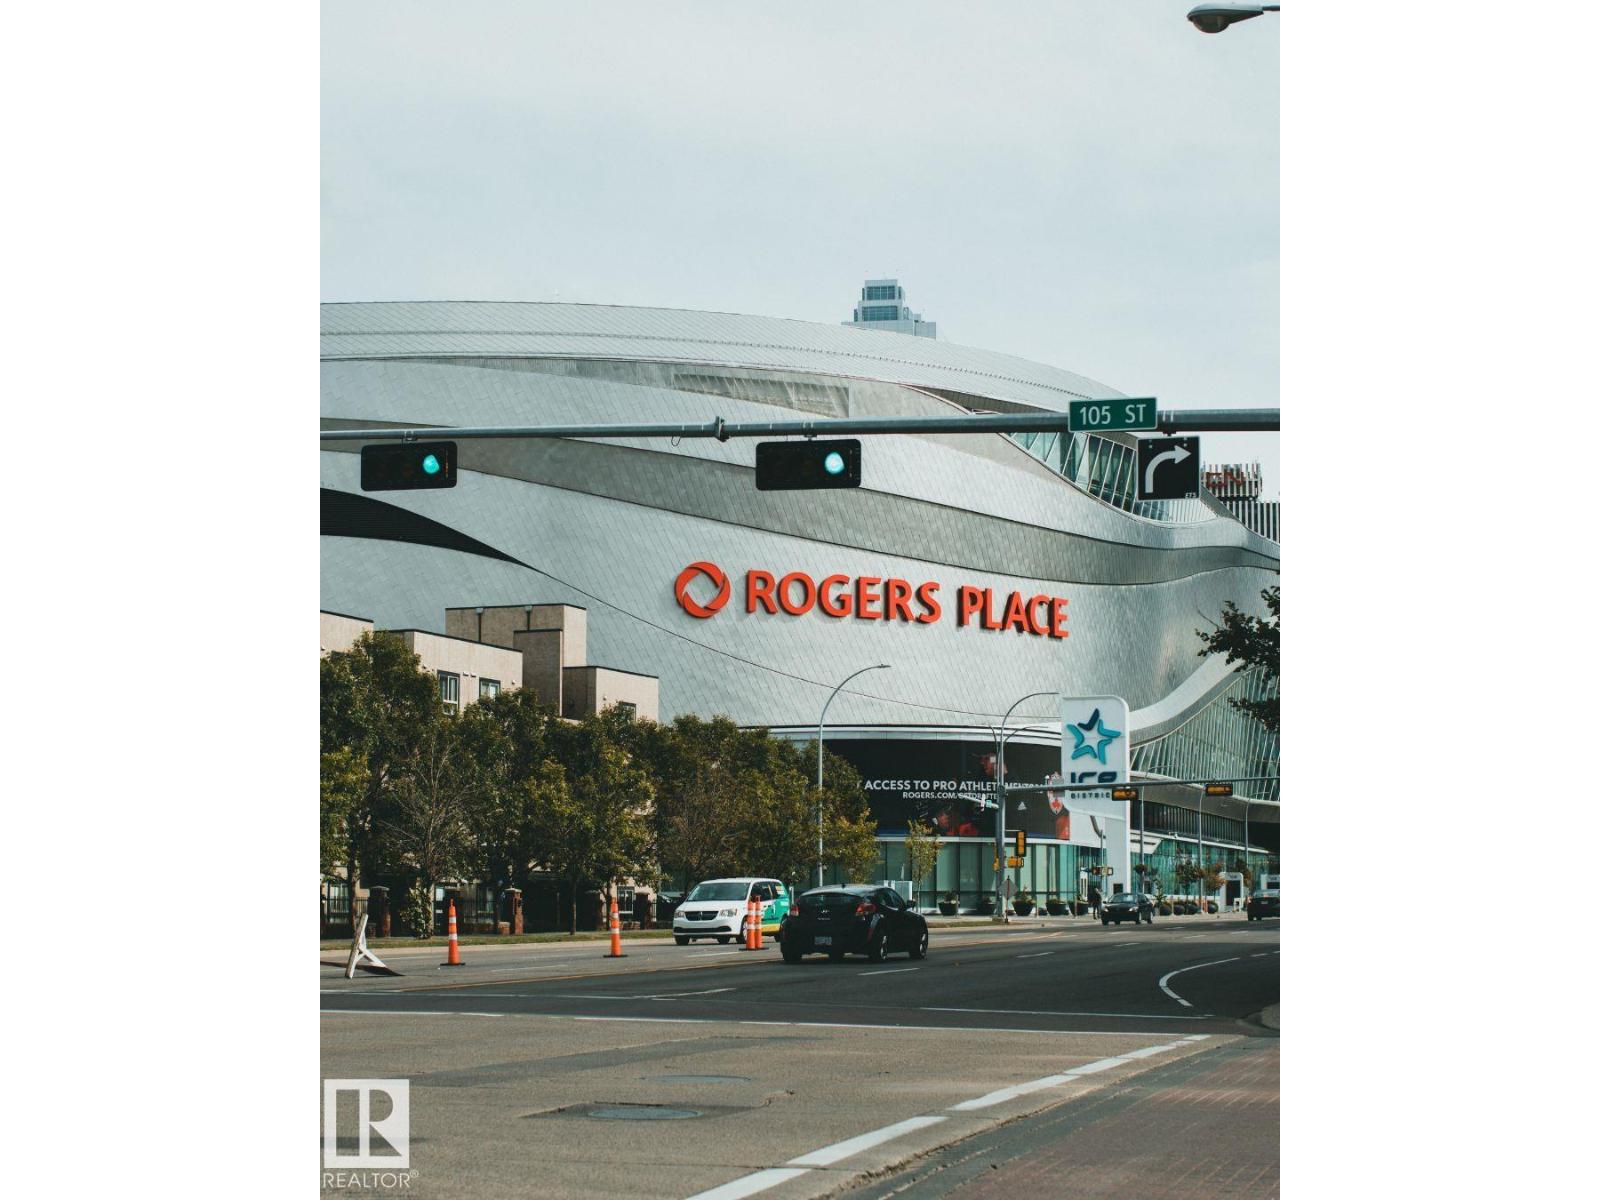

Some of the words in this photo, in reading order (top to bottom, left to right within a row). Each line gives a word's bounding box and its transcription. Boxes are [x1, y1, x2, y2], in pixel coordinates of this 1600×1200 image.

[1079, 405, 1111, 425] 105
[1125, 404, 1147, 423] ST
[746, 569, 941, 624] ROGERS
[958, 585, 1069, 639] PLACE
[864, 780, 911, 790] ACCESS
[913, 780, 931, 790] TO
[933, 780, 957, 790] PRO
[959, 781, 998, 791] ATHLET
[1071, 792, 1111, 800] DISTRIC
